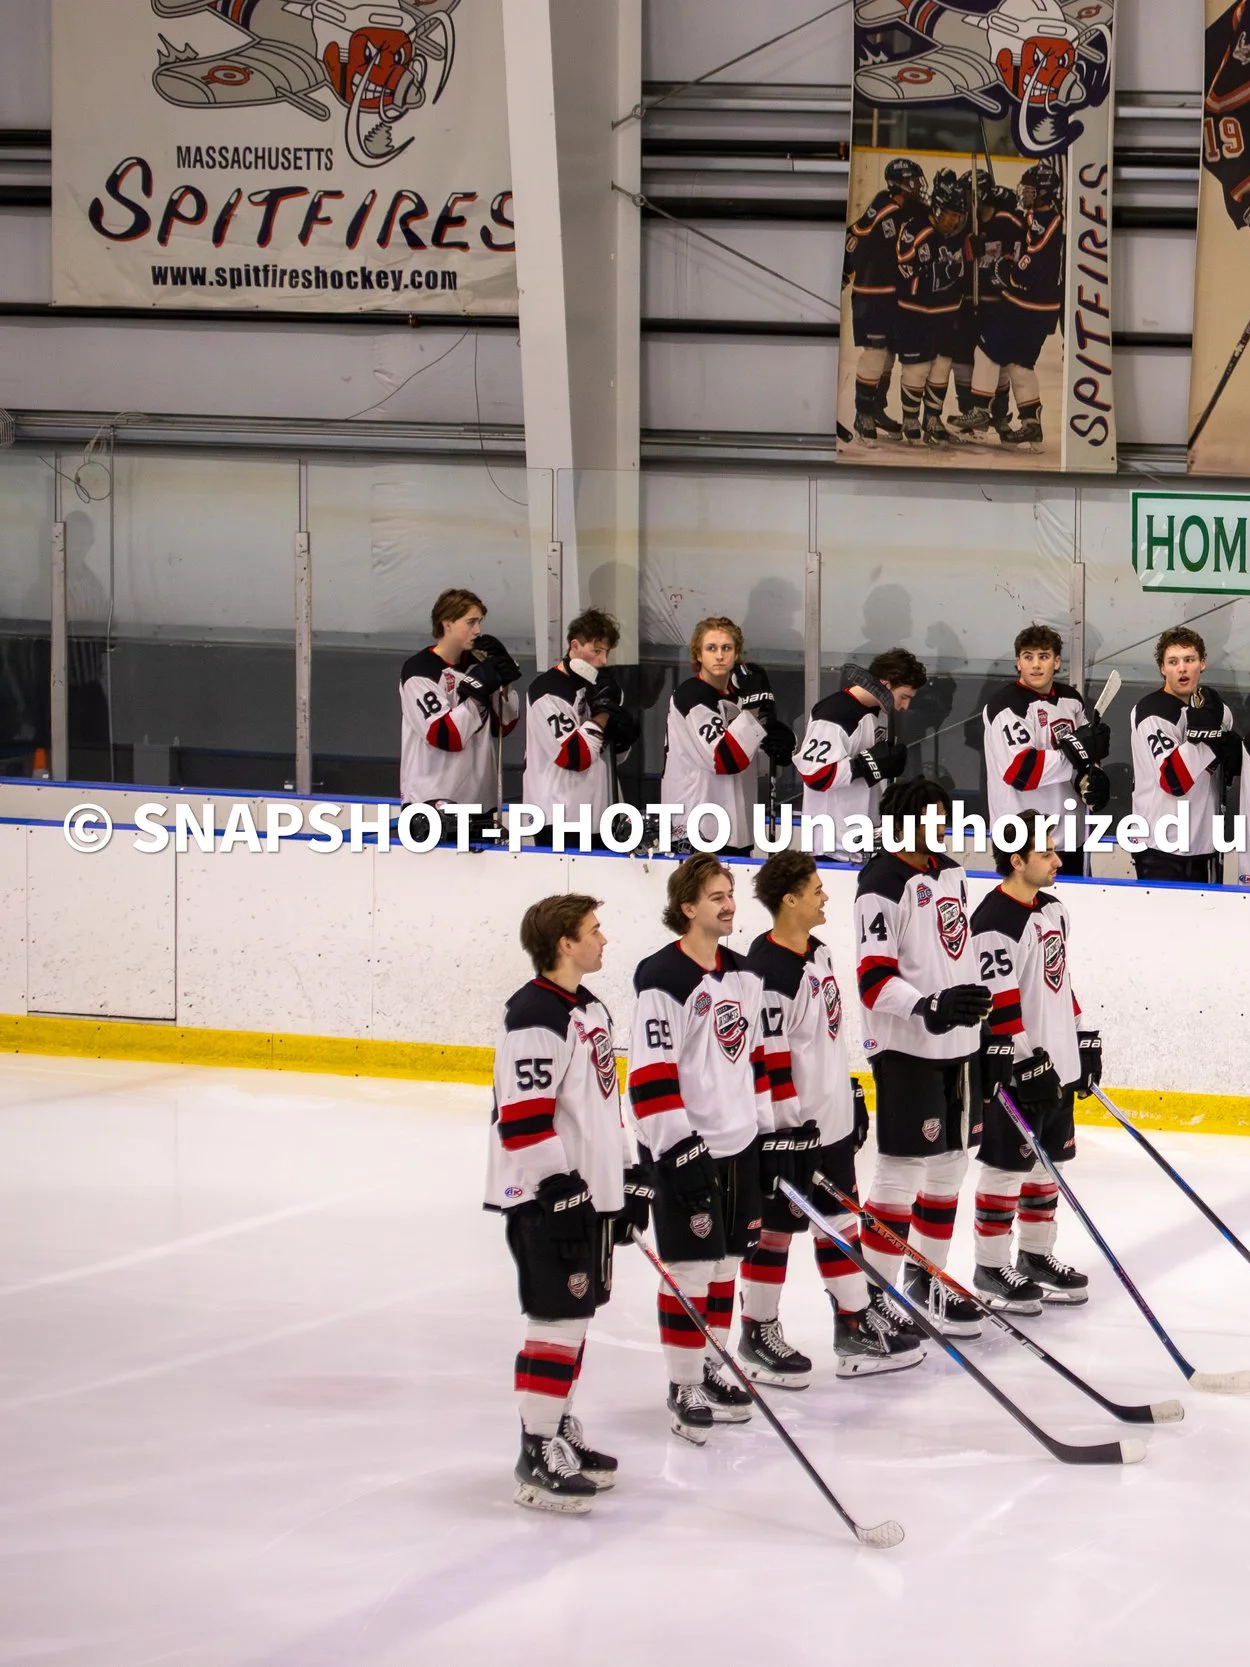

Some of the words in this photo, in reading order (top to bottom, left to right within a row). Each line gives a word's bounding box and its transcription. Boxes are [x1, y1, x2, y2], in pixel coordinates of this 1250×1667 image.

[176, 144, 334, 172] MASSACHUSETTS
[151, 263, 458, 293] www.spitfireshockey.com
[1070, 161, 1112, 448] SPITFIRES
[416, 690, 442, 720] 18
[1003, 720, 1031, 747] 13
[1147, 728, 1175, 760] 26
[802, 738, 832, 764] 22
[861, 912, 887, 944] 14
[980, 948, 1013, 981] 25
[761, 1007, 783, 1038] 17
[514, 1058, 553, 1091] 55
